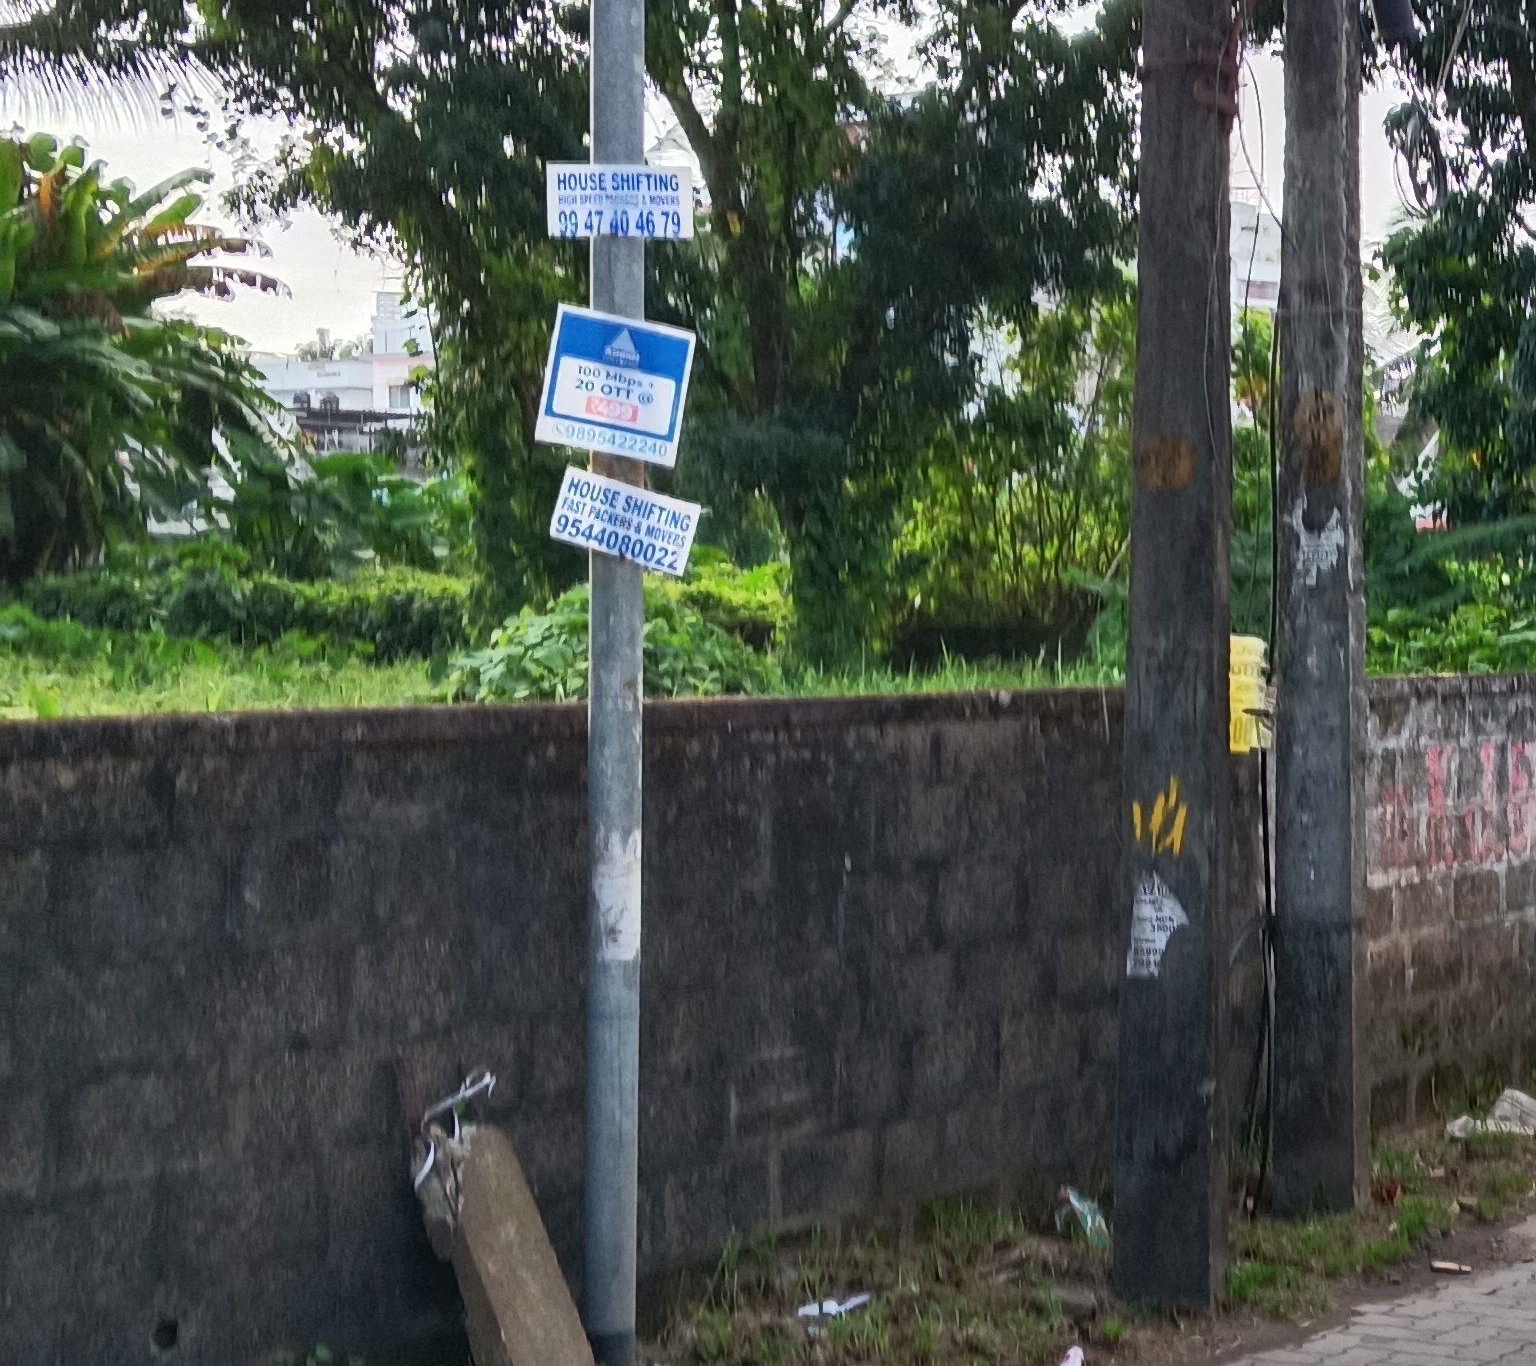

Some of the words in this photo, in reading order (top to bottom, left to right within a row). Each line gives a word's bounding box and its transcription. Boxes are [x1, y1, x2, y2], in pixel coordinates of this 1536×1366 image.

[557, 173, 606, 192] HOUSE
[611, 172, 679, 192] SHIFTING
[558, 210, 578, 239] 99
[584, 209, 603, 235] 47
[609, 209, 629, 237] 40
[635, 209, 655, 239] 46
[661, 210, 681, 239] 79
[575, 378, 595, 392] 20
[601, 383, 634, 400] OTT
[638, 392, 654, 405] @
[578, 364, 601, 379] 100
[605, 370, 643, 388] Mbps
[565, 425, 668, 458] 9895422240
[568, 476, 621, 510] HOUSE
[622, 495, 692, 533] SHIFTING
[562, 497, 587, 515] FAST
[588, 505, 633, 531] PACKERS
[634, 520, 642, 535] &
[644, 524, 687, 550] MOVERS
[555, 513, 679, 571] 9544080022
